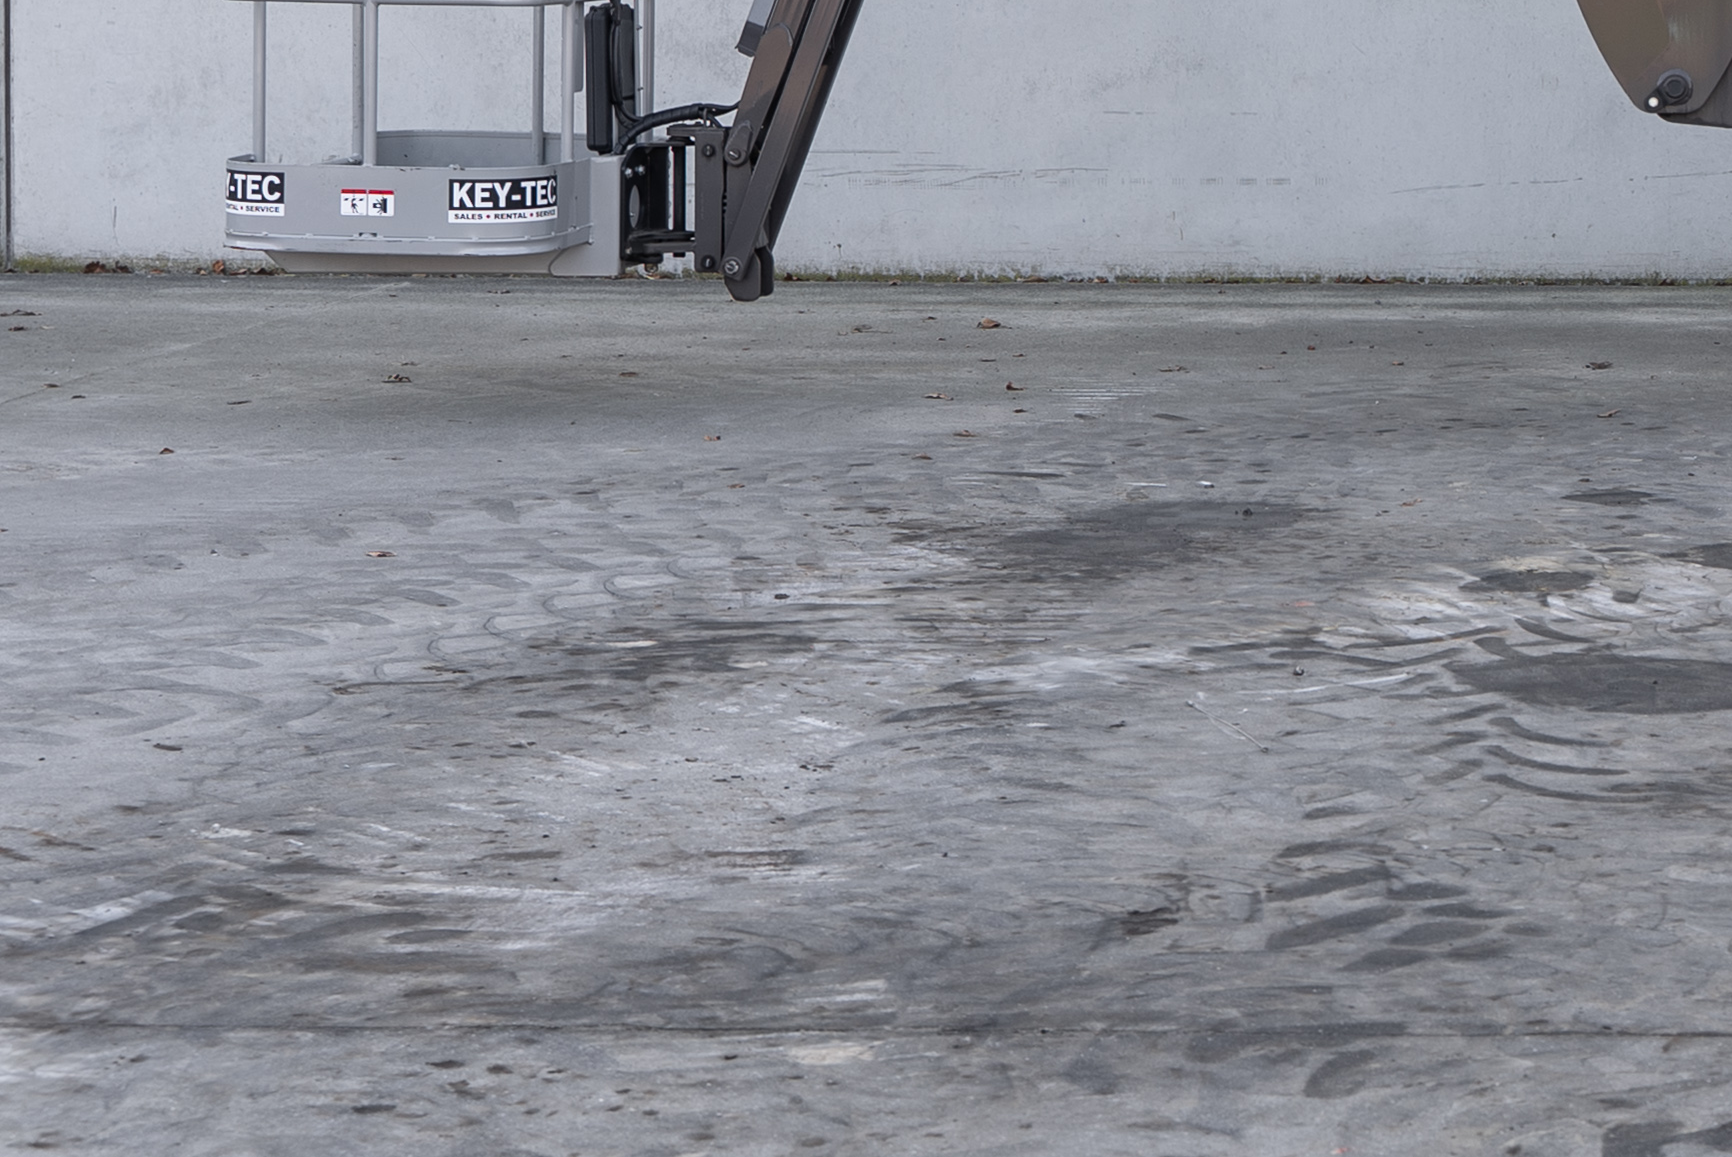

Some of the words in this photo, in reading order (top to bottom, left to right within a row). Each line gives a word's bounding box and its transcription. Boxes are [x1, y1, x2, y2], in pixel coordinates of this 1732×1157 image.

[452, 178, 557, 208] KEY-TEC
[245, 205, 280, 213] SERVICE
[494, 211, 528, 220] RENTAL
